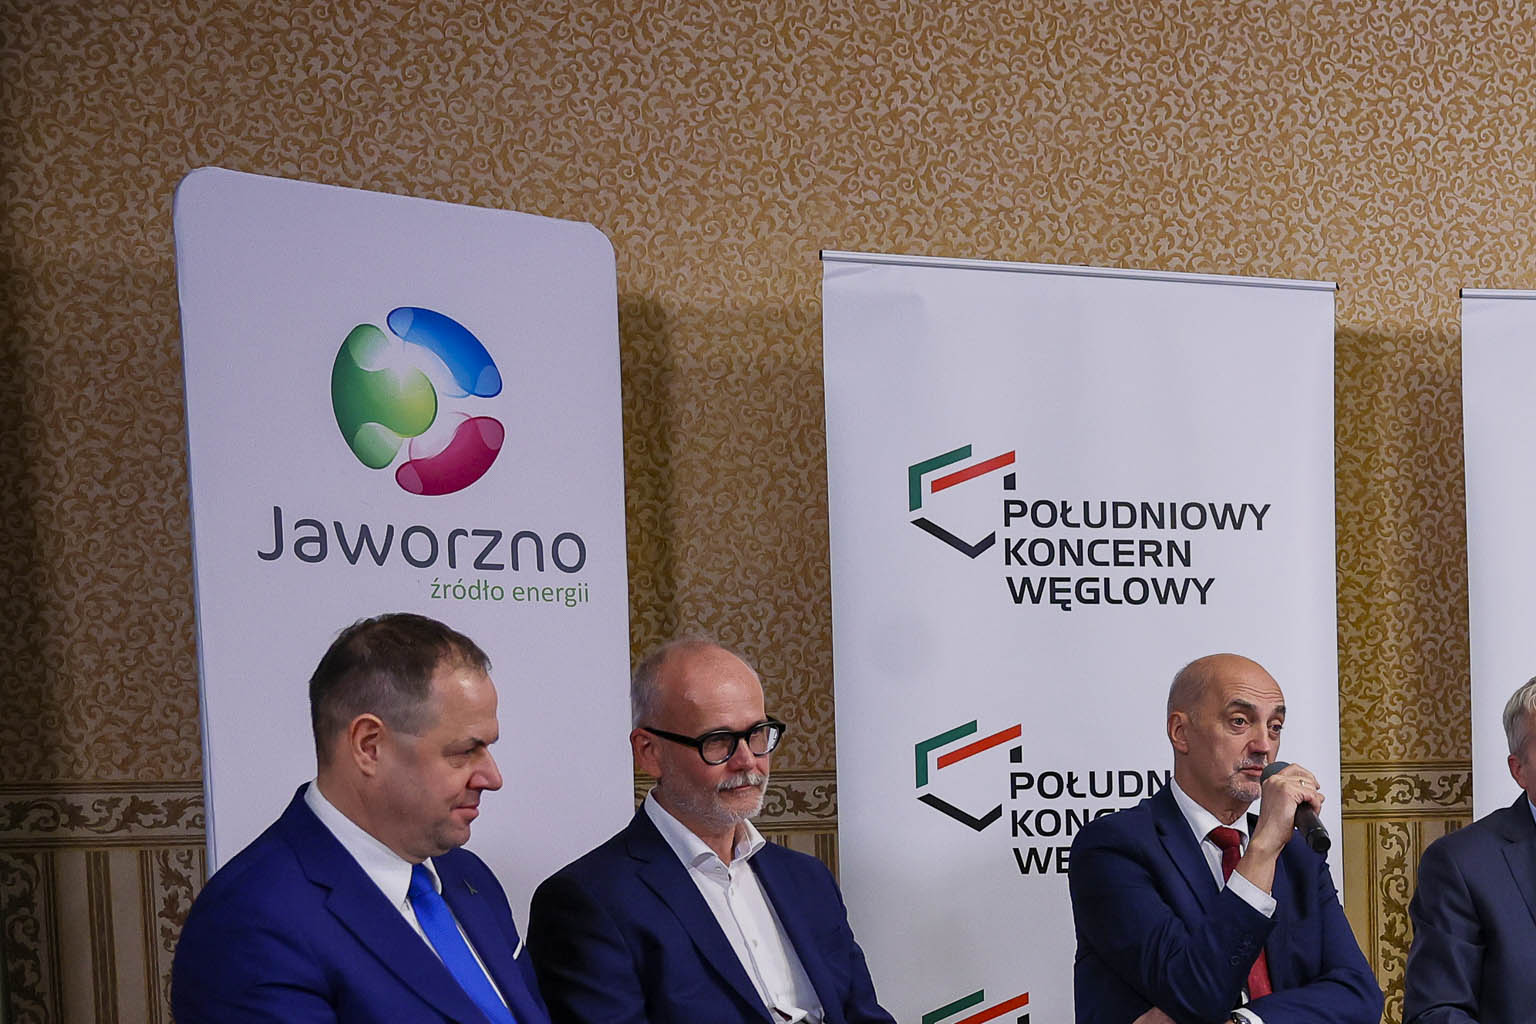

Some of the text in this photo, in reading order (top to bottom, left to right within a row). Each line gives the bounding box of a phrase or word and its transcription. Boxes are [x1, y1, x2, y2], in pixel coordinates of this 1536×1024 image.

[1003, 499, 1271, 531] POŁUDNIOWY
[257, 505, 587, 574] Jaworzno
[1004, 537, 1191, 567] KONCERN
[430, 577, 589, 607] źródło energii
[1006, 576, 1215, 611] WĘGLOWY
[1010, 770, 1171, 799] POŁUDN
